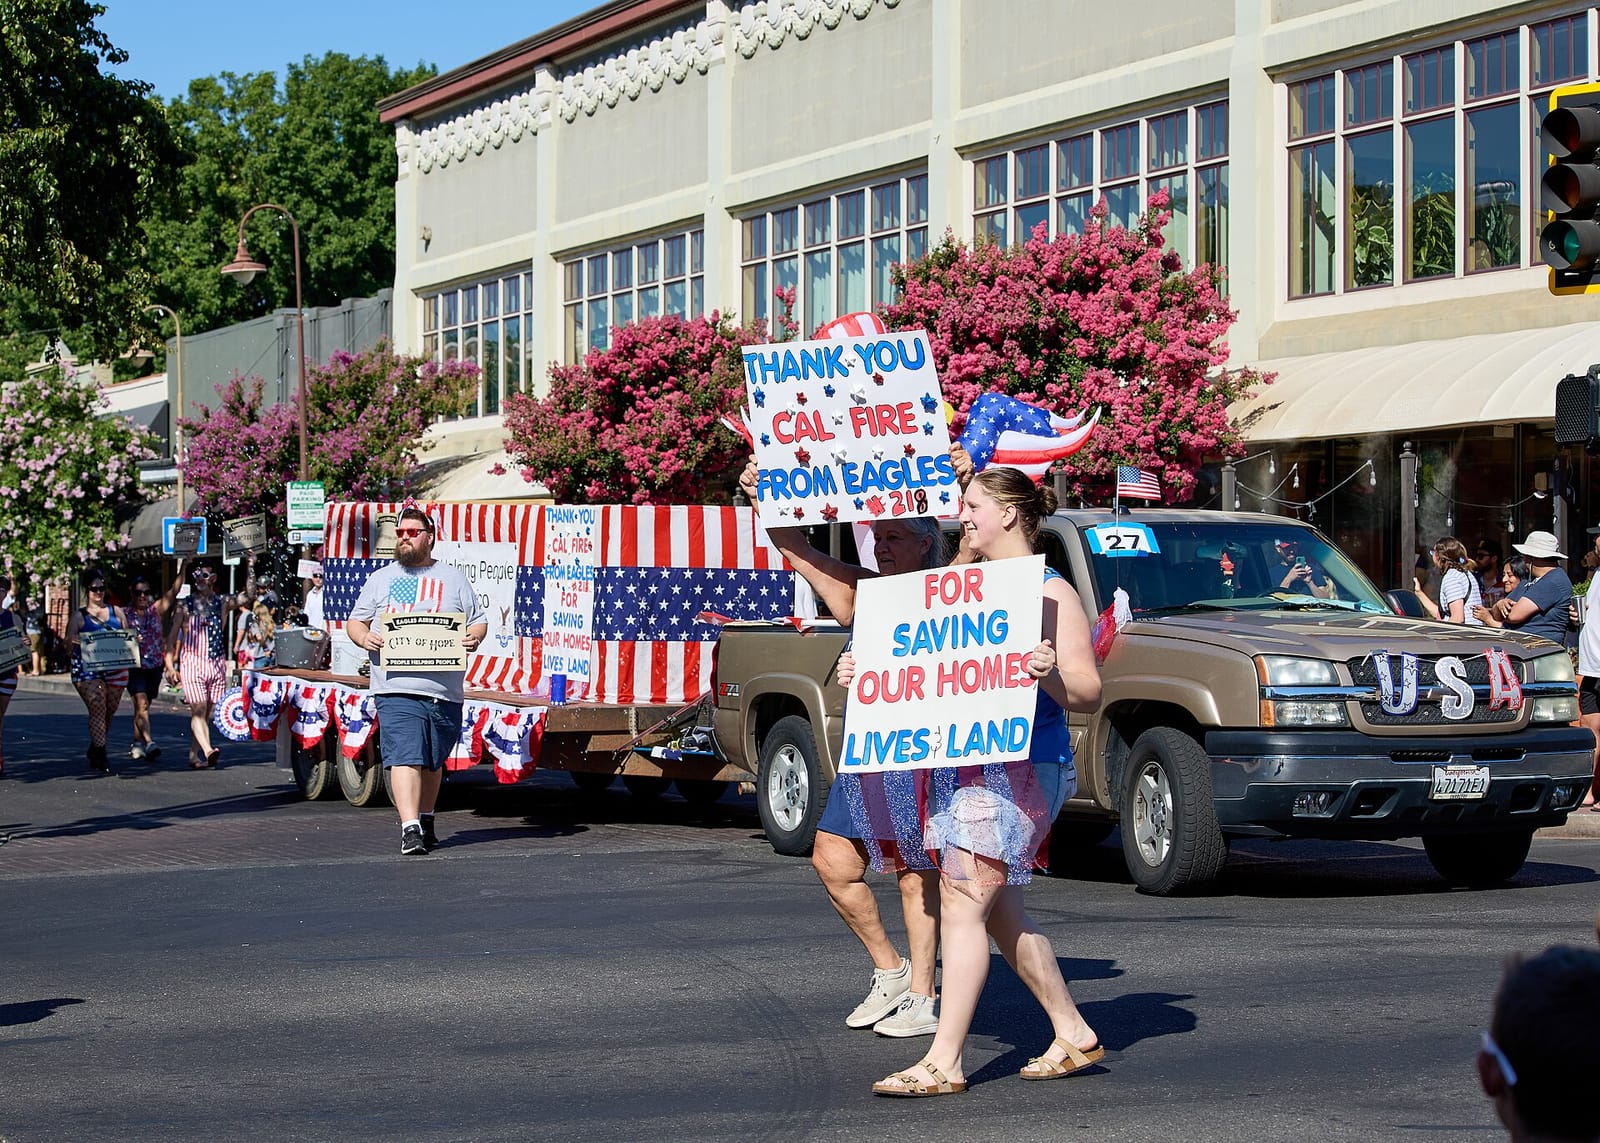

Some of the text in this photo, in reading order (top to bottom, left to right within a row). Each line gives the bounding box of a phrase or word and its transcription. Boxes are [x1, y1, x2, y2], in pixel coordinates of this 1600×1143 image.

[743, 338, 926, 385] THANK YOU
[772, 401, 919, 444] CAL FIRE
[756, 453, 955, 502] FROM EAGLES
[545, 507, 596, 525] THANK YOU
[552, 537, 589, 554] CAL FIRE
[1105, 533, 1141, 551] 27
[479, 561, 514, 584] People
[545, 564, 594, 581] FROM EAGLES
[925, 568, 984, 609] FOR
[561, 591, 578, 608] FOR
[552, 611, 584, 629] SAVING
[544, 631, 591, 651] OUR HOMES
[892, 610, 1009, 657] SAVING
[543, 654, 589, 676] LIVES LAND
[856, 651, 1035, 705] OUR HOMES
[719, 683, 739, 696] Z71
[844, 728, 930, 767] LIVES
[946, 717, 1030, 757] LAND
[1435, 778, 1485, 793] 47171E1
